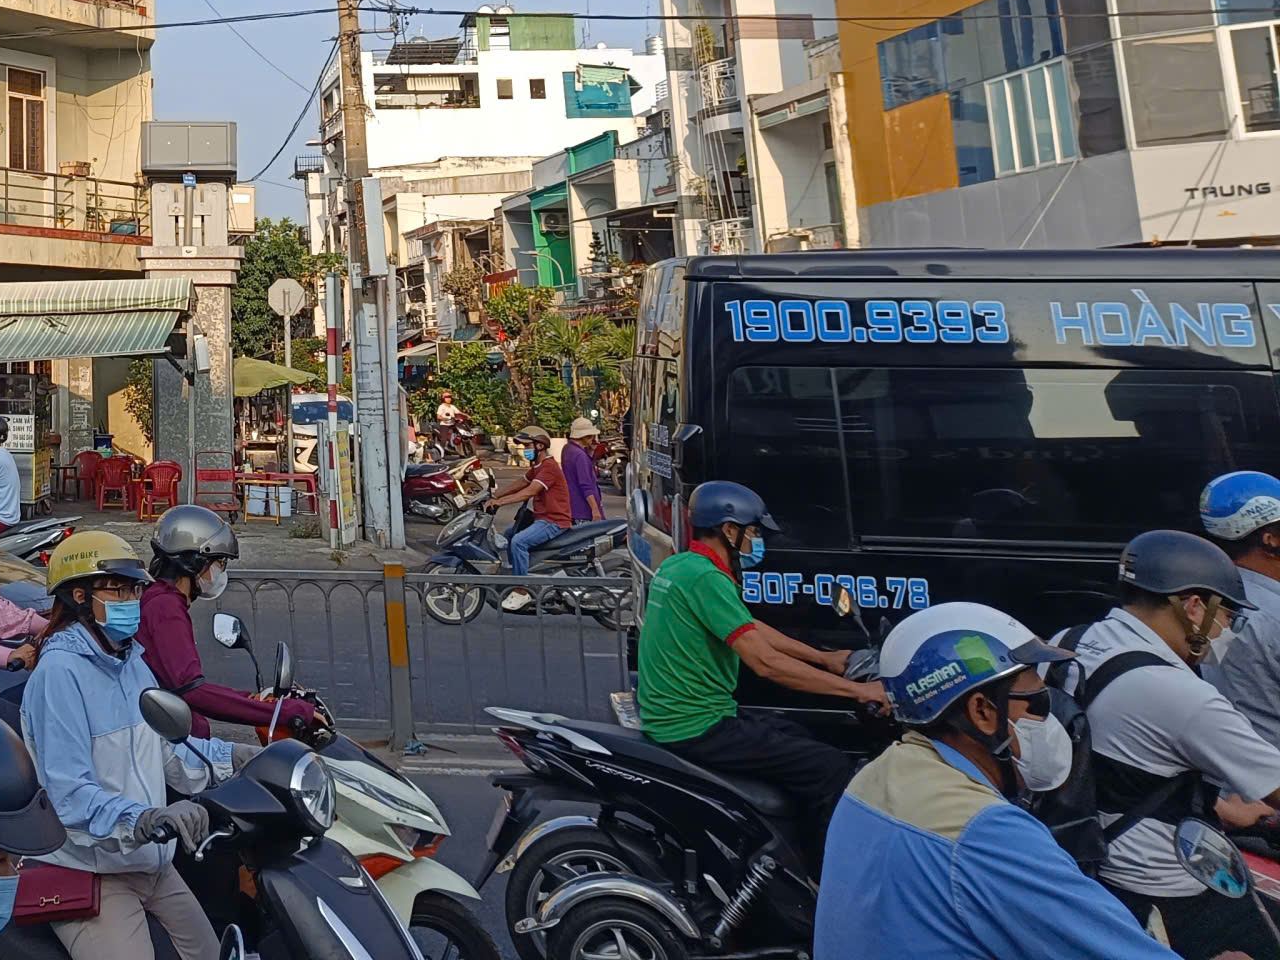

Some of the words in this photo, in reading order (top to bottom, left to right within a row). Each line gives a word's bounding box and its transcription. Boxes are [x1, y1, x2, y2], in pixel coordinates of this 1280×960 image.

[1184, 182, 1271, 200] TRUNG
[724, 298, 1010, 344] 1900.9393
[1049, 288, 1257, 348] HOÀNG
[80, 550, 99, 560] BIKE
[905, 661, 963, 698] PLASMAN
[585, 760, 651, 785] VISION
